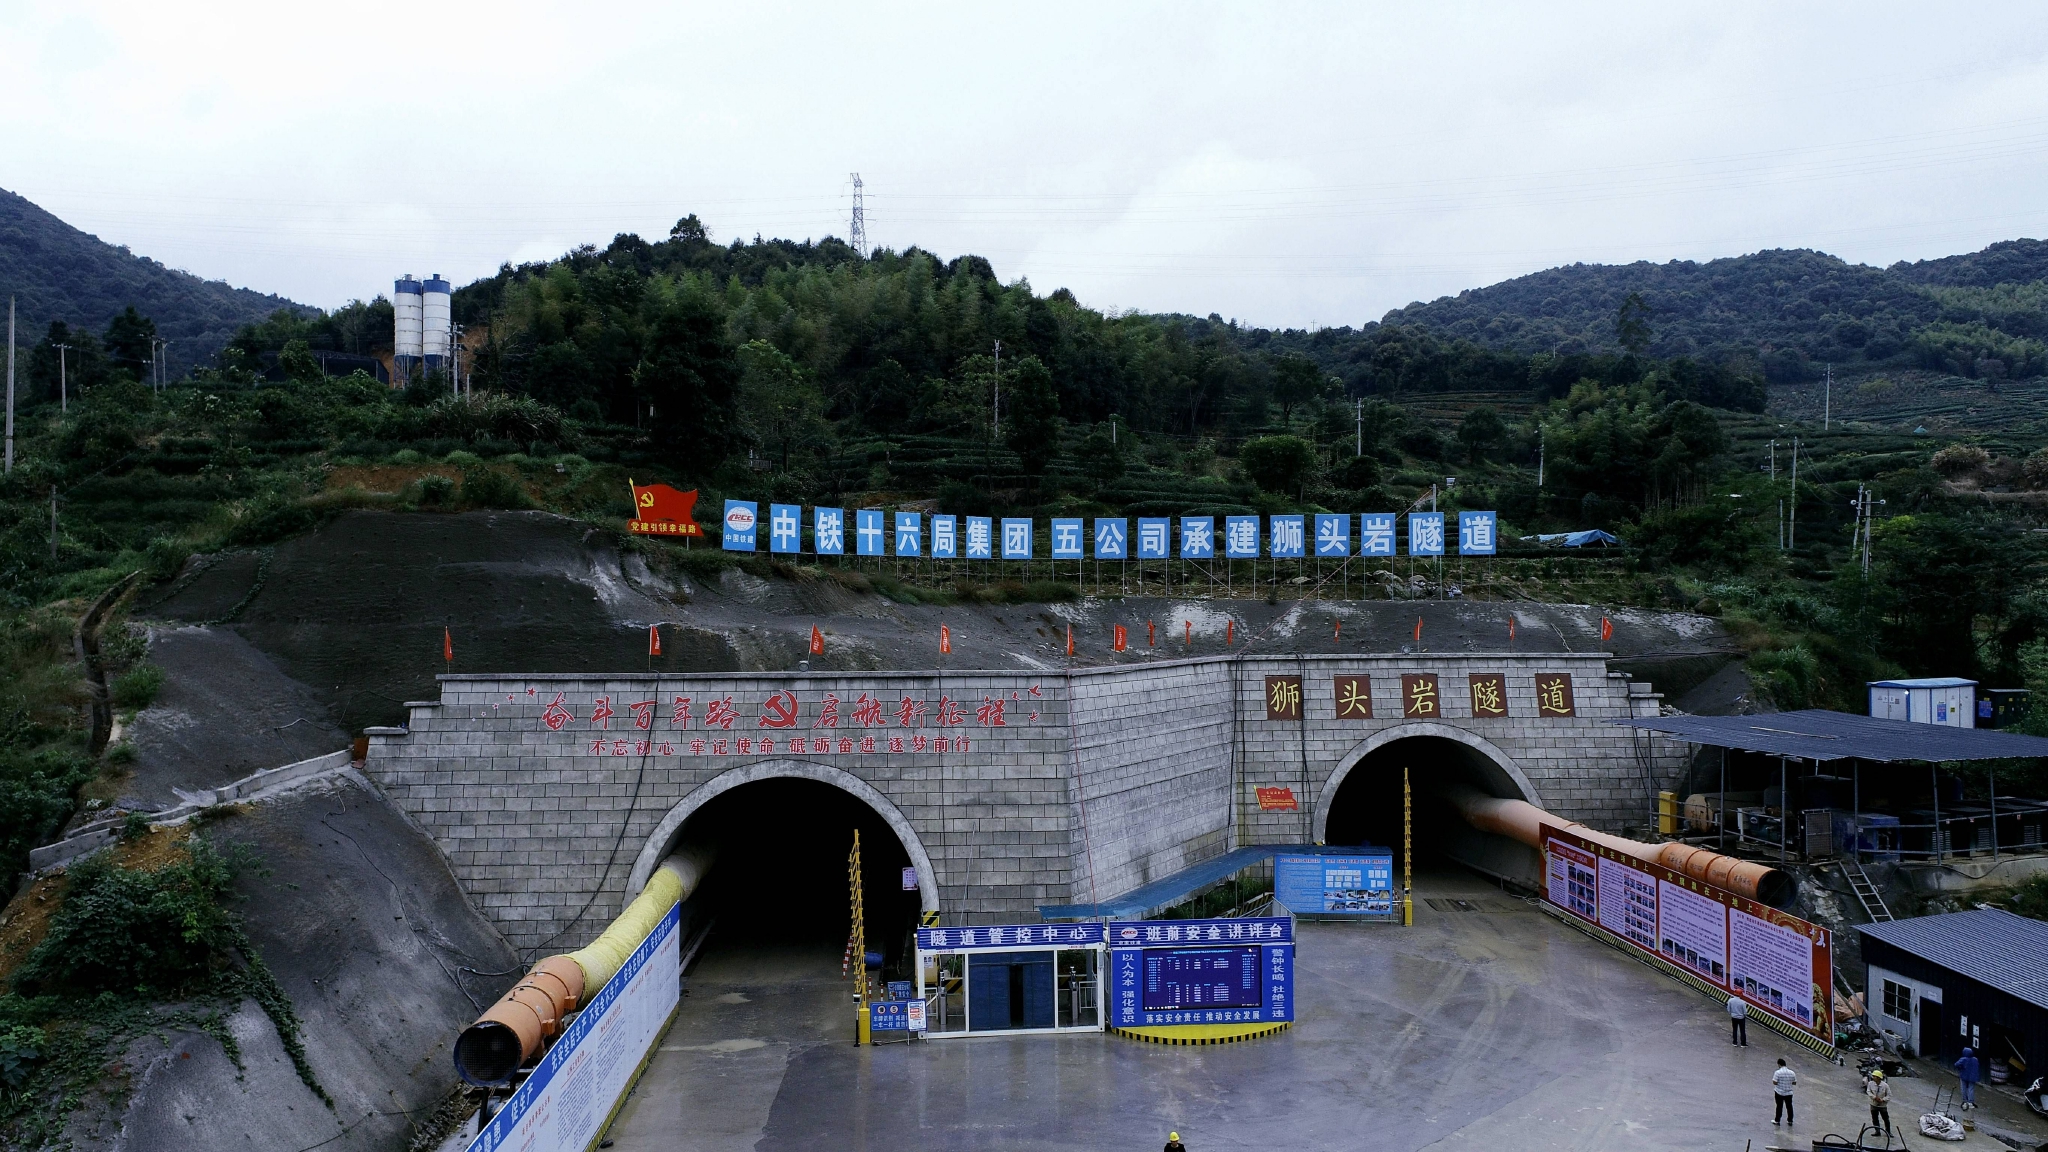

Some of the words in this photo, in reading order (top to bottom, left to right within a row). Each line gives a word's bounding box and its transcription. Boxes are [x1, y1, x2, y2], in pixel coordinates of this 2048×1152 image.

[631, 521, 696, 534] 党建引领幸福路
[725, 533, 754, 544] 中国铁建
[773, 509, 1494, 556] 中铁十六局集团五公司承建狮头岩隧道
[541, 691, 742, 730] 奋斗百年路
[813, 692, 1007, 729] 启航新征程
[1269, 678, 1571, 716] 狮头岩隧道
[589, 738, 675, 756] 不忘初心
[689, 737, 775, 755] 牢记使命
[789, 736, 876, 754] 砥砺奋进
[888, 735, 972, 754] 逐梦前行
[930, 926, 1087, 946] 隧道管控中心
[1145, 923, 1283, 942] 班前安全讲评台
[1121, 953, 1135, 987] 以人为本
[1271, 948, 1285, 982] 警钟长鸣
[1121, 990, 1135, 1023] 强化意识
[1146, 1012, 1201, 1024] 落实安全责任
[1205, 1010, 1260, 1021] 推动安全发展
[1271, 985, 1286, 1018] 杜绝三违
[511, 1082, 534, 1125] 促生产
[551, 1015, 587, 1074] 先安全后生产
[589, 978, 619, 1025] 不安全不生产
